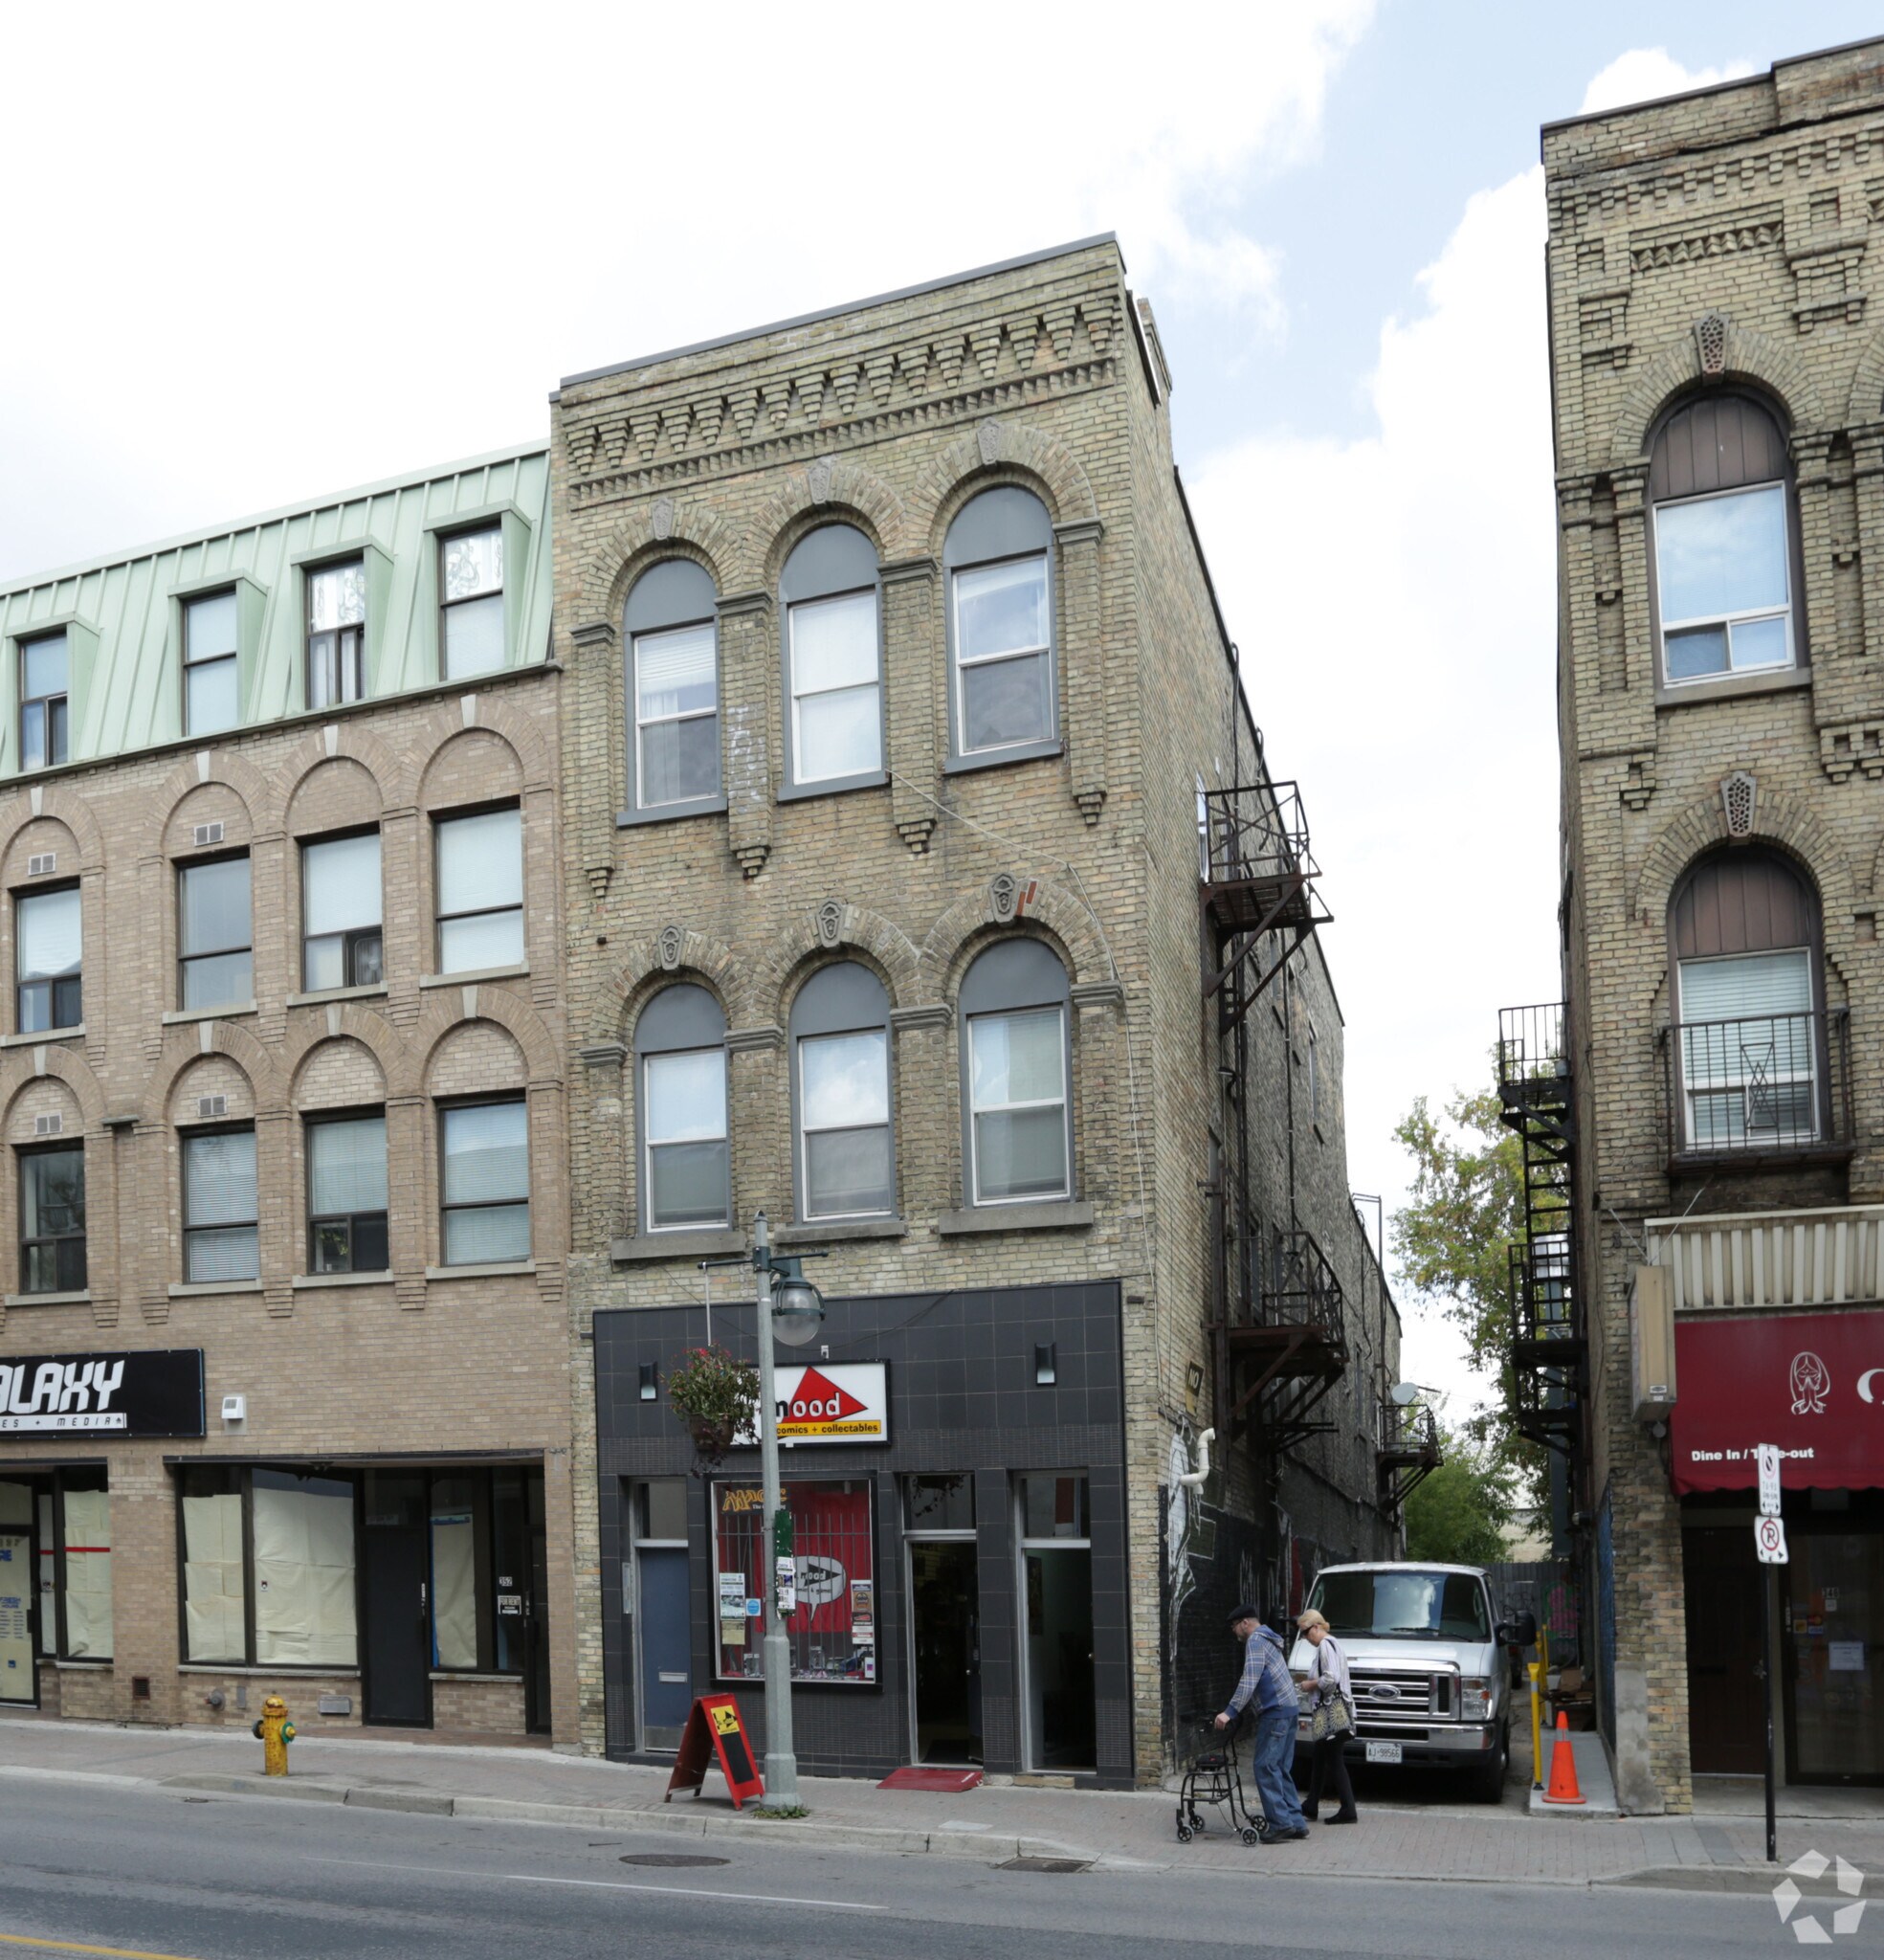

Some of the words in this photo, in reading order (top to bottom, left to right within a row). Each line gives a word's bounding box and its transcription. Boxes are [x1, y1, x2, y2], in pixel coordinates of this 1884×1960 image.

[1188, 1369, 1199, 1389] NO
[56, 1416, 111, 1427] MEDIA
[776, 1425, 809, 1435] comics
[821, 1422, 878, 1434] collectables
[1691, 1449, 1723, 1461] Dine
[1726, 1449, 1740, 1459] In
[1750, 1447, 1814, 1459] Te-out
